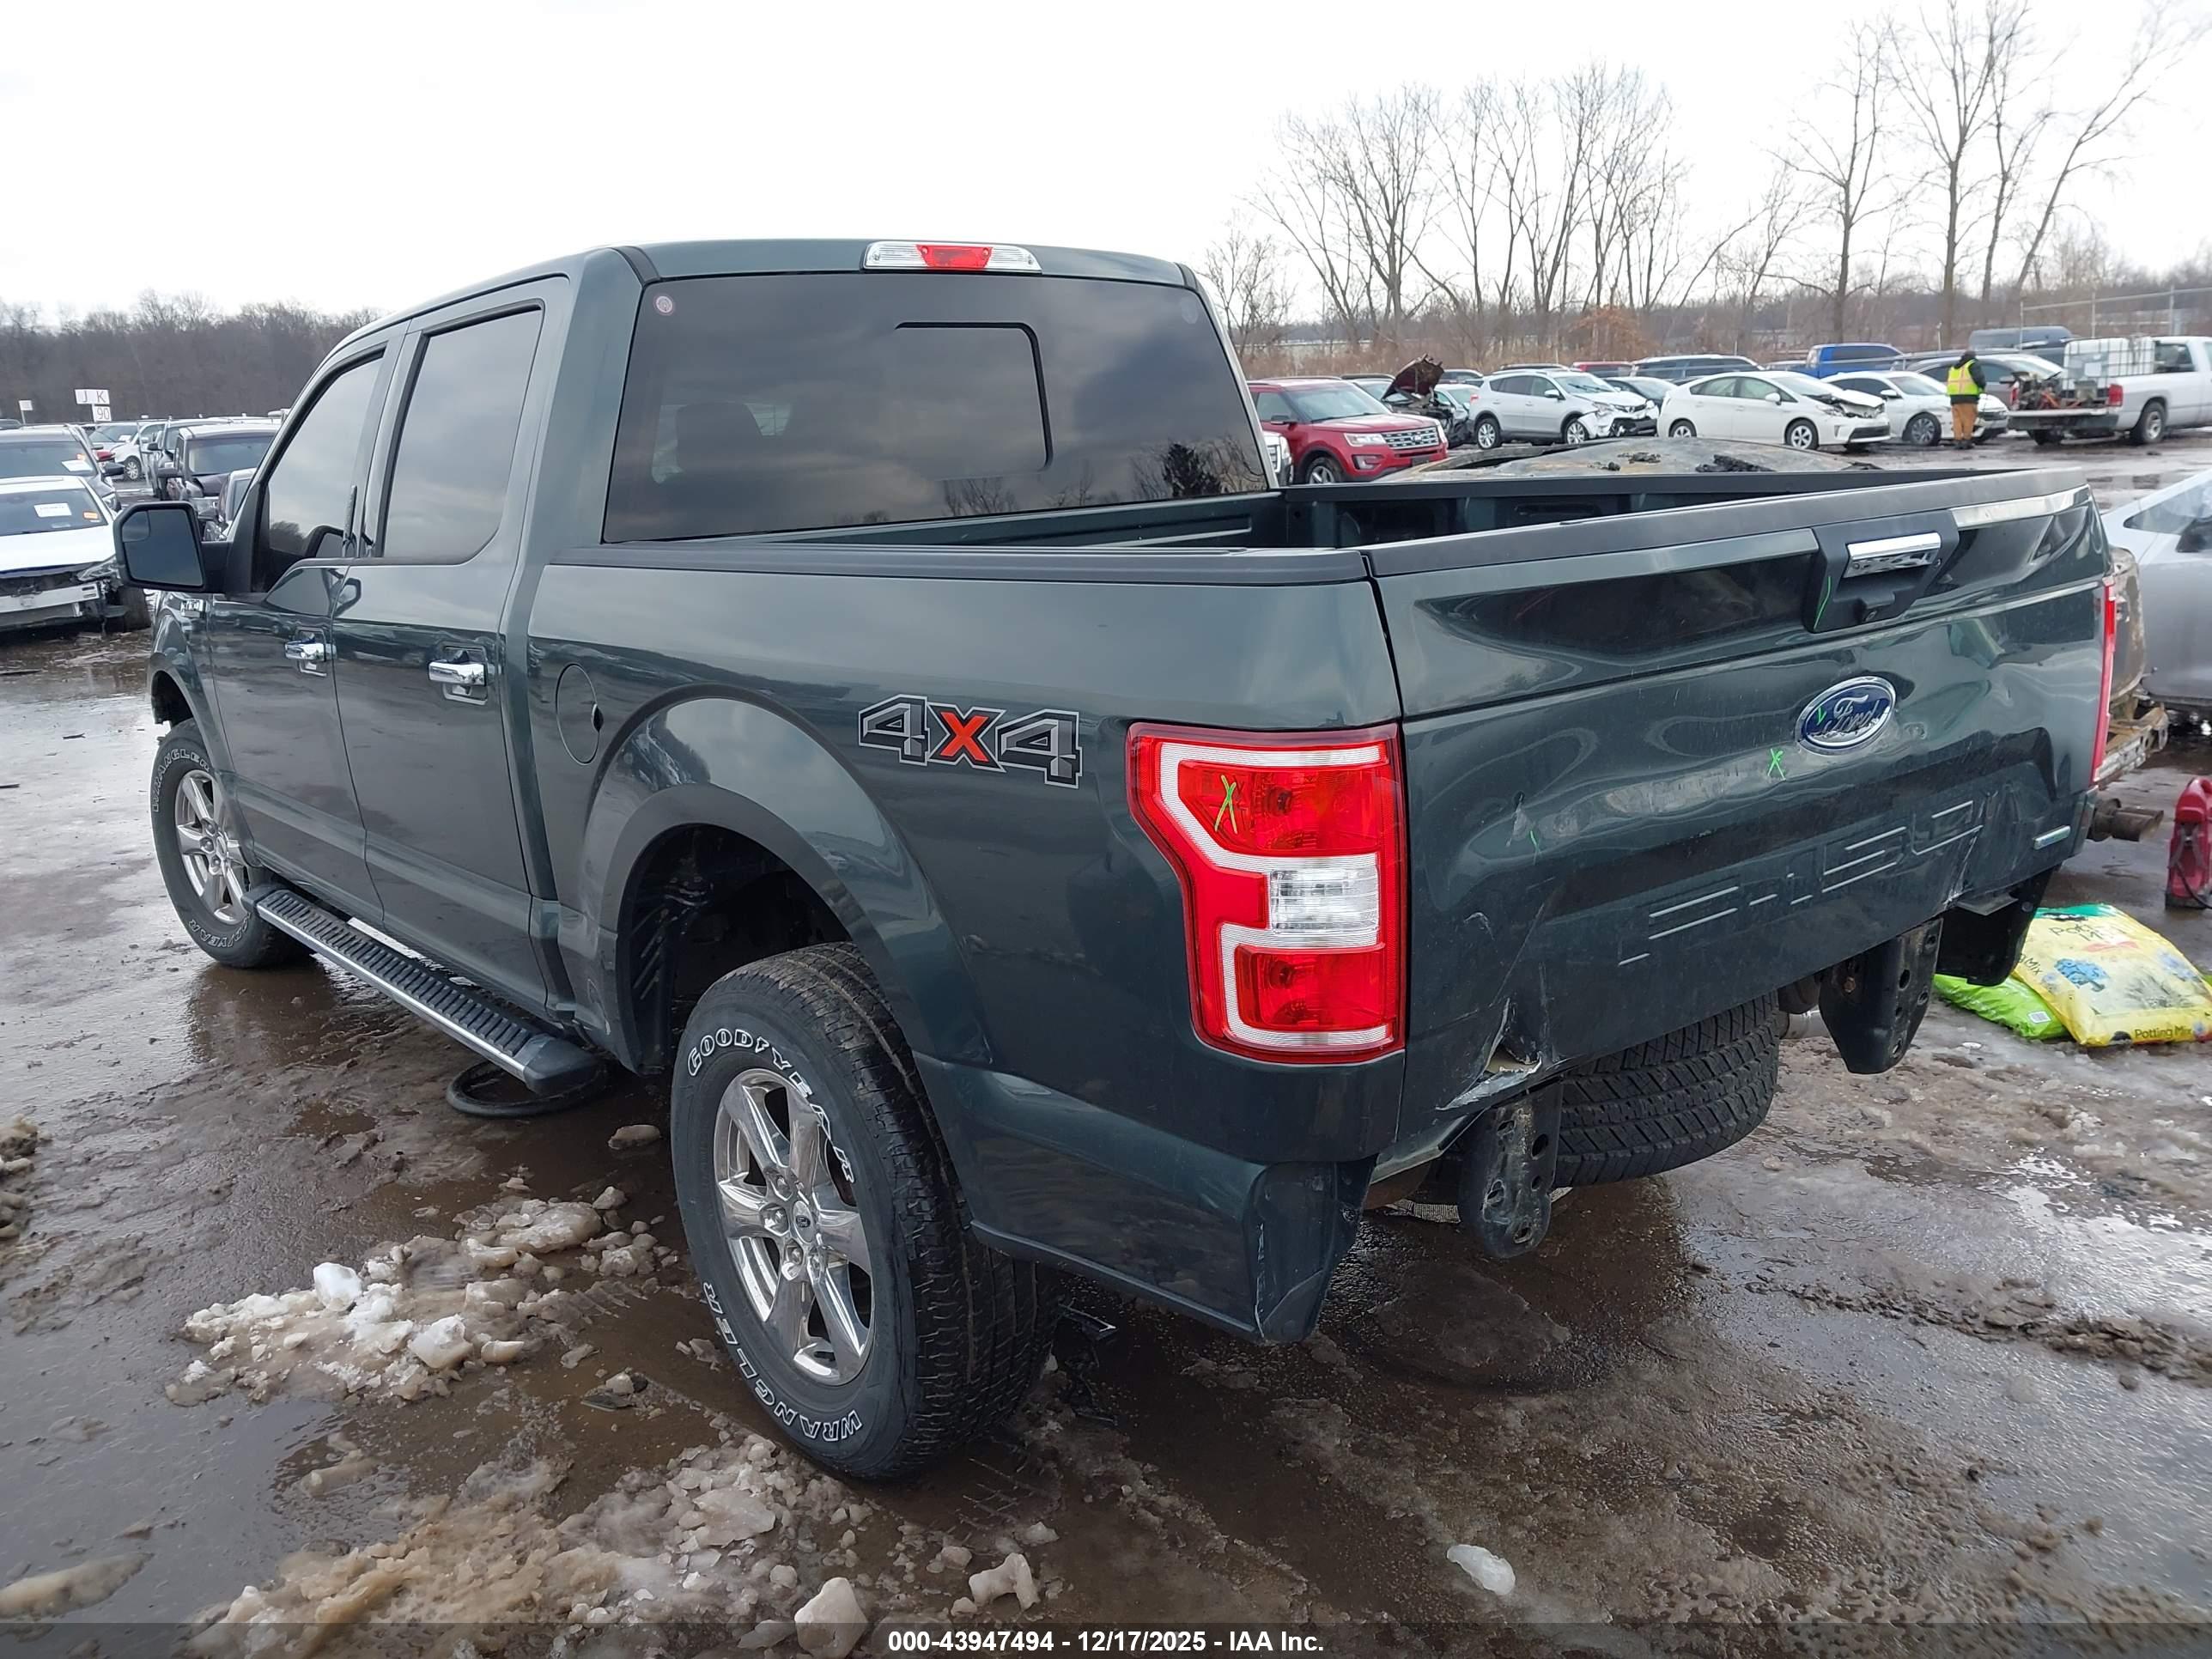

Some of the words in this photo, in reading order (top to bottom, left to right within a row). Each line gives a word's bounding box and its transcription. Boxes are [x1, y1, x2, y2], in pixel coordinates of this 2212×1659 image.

[96, 390, 106, 404] K
[96, 407, 111, 421] 90
[2134, 1027, 2173, 1039] Potting
[702, 1281, 863, 1442] WRANGLER
